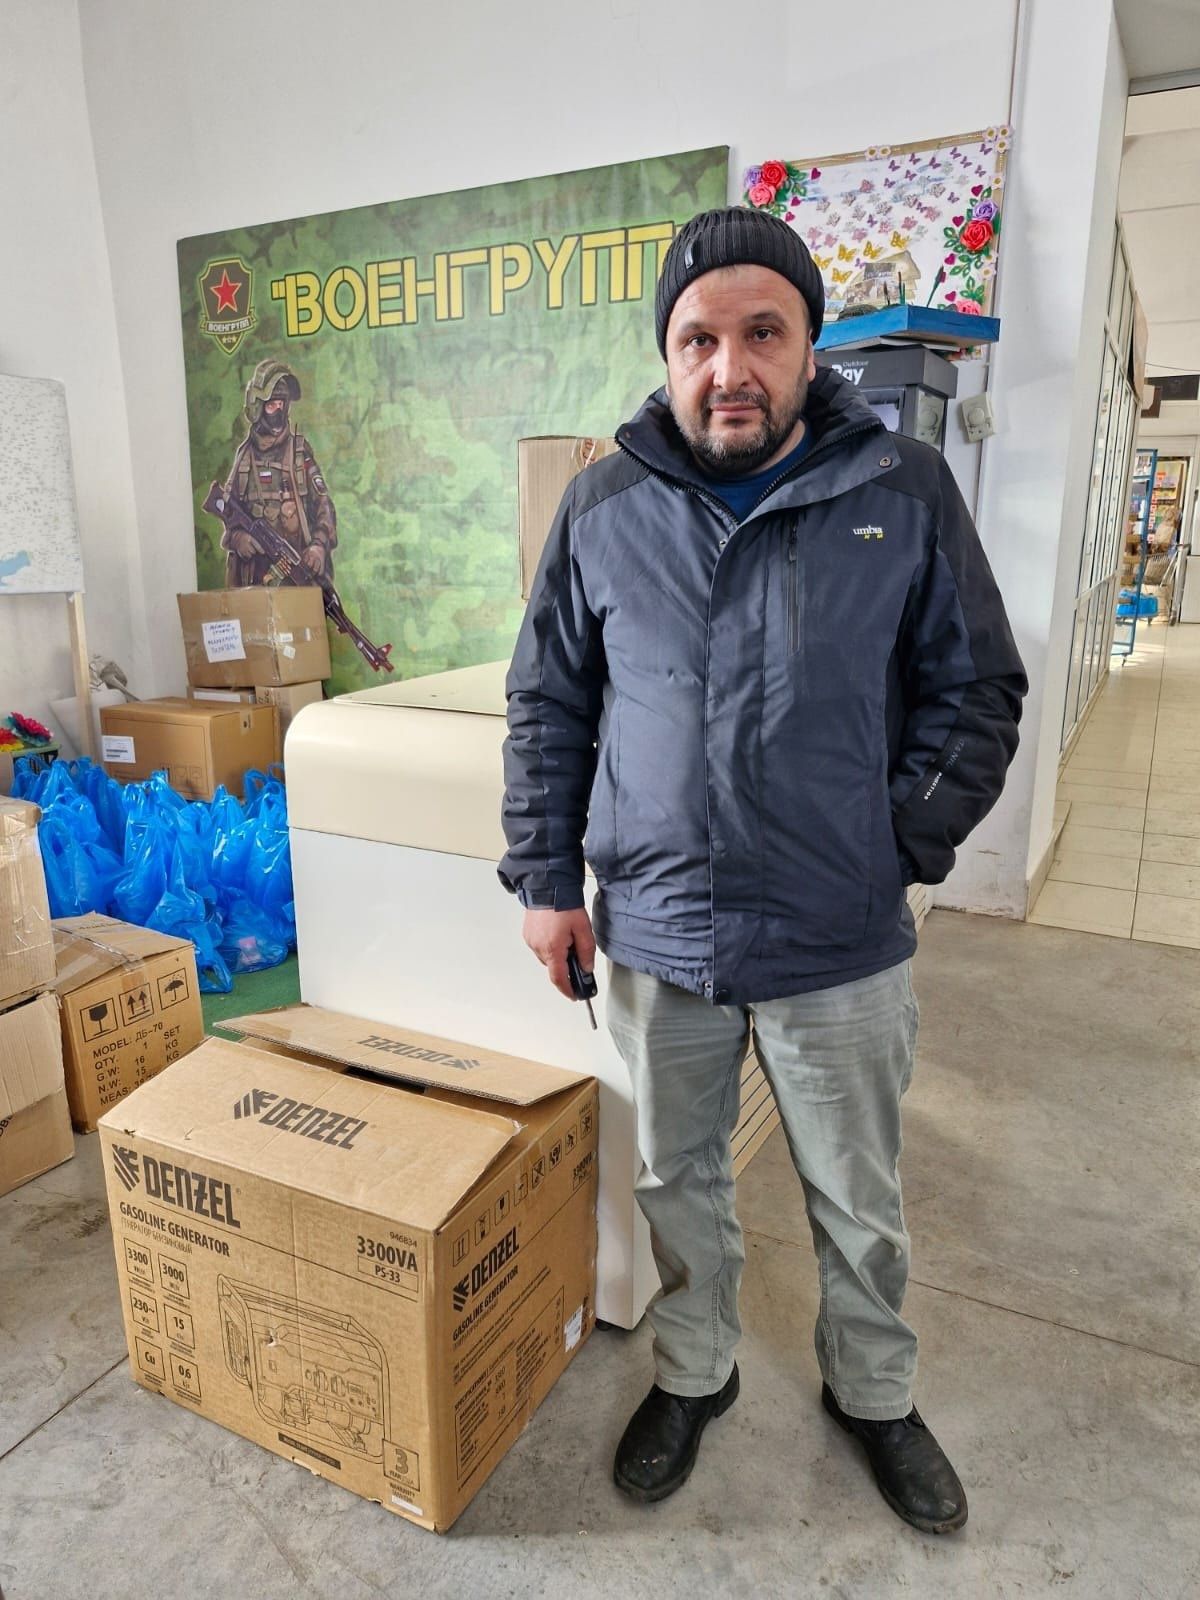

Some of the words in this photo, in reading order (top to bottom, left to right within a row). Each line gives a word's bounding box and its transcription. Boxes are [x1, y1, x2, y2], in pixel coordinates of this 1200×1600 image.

[271, 220, 684, 337] "ВОЕНГРУПП
[163, 1025, 181, 1040] SET
[92, 1037, 132, 1059] MODEL:
[165, 1039, 179, 1051] KG
[166, 1050, 180, 1063] KG
[258, 1097, 369, 1150] DENZEL
[142, 1154, 241, 1229] DENZEL
[119, 1201, 166, 1232] GASOLINE
[167, 1221, 231, 1258] GENERATOR
[127, 1247, 149, 1266] 3300
[357, 1235, 419, 1273] 3300VA
[471, 1225, 520, 1297] DENZEL
[161, 1262, 185, 1282] 3000
[375, 1264, 401, 1283] PS-33
[453, 1303, 485, 1341] GASOLINE
[484, 1264, 519, 1308] GENERATOR
[173, 1316, 185, 1331] 15
[144, 1351, 156, 1366] Cu
[395, 1448, 409, 1475] 3
